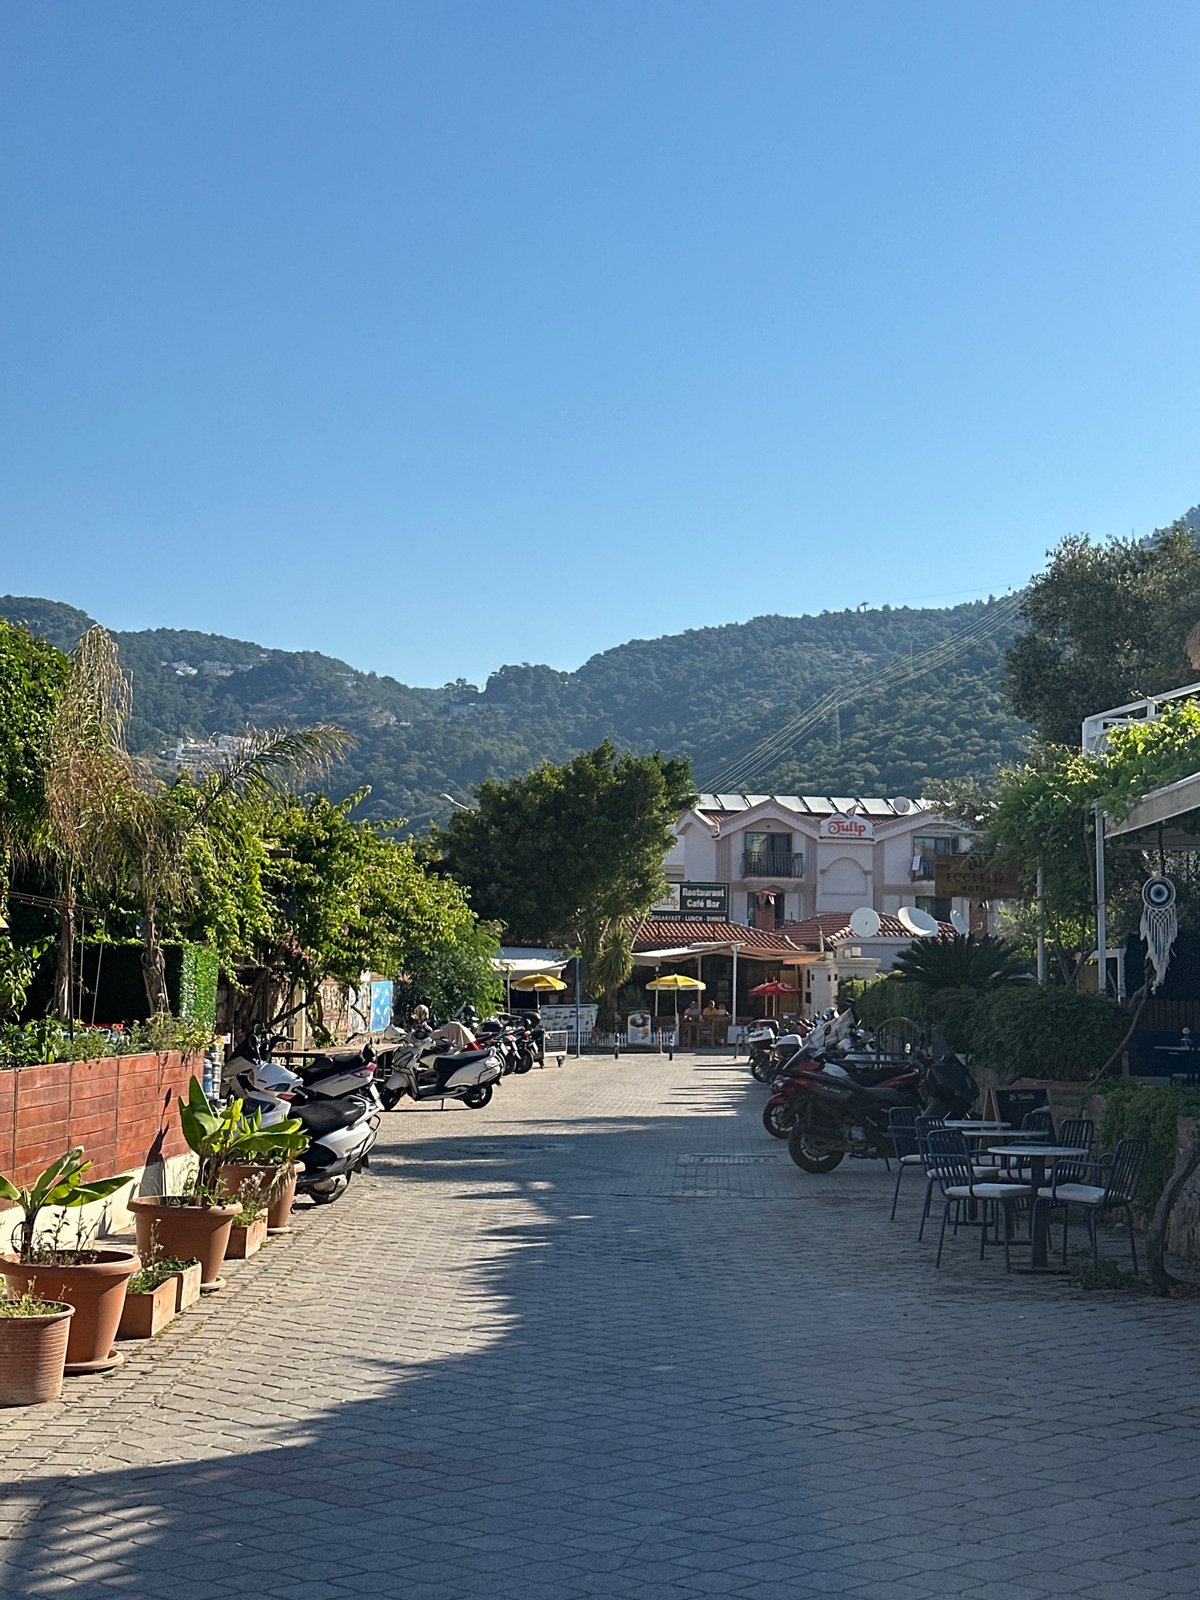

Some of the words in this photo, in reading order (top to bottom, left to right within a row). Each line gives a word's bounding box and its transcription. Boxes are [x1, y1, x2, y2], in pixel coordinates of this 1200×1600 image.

[828, 820, 866, 836] Tulip
[682, 888, 725, 897] Restaurant
[961, 885, 992, 894] HOTEL
[686, 899, 704, 908] Café
[706, 900, 720, 908] Bar
